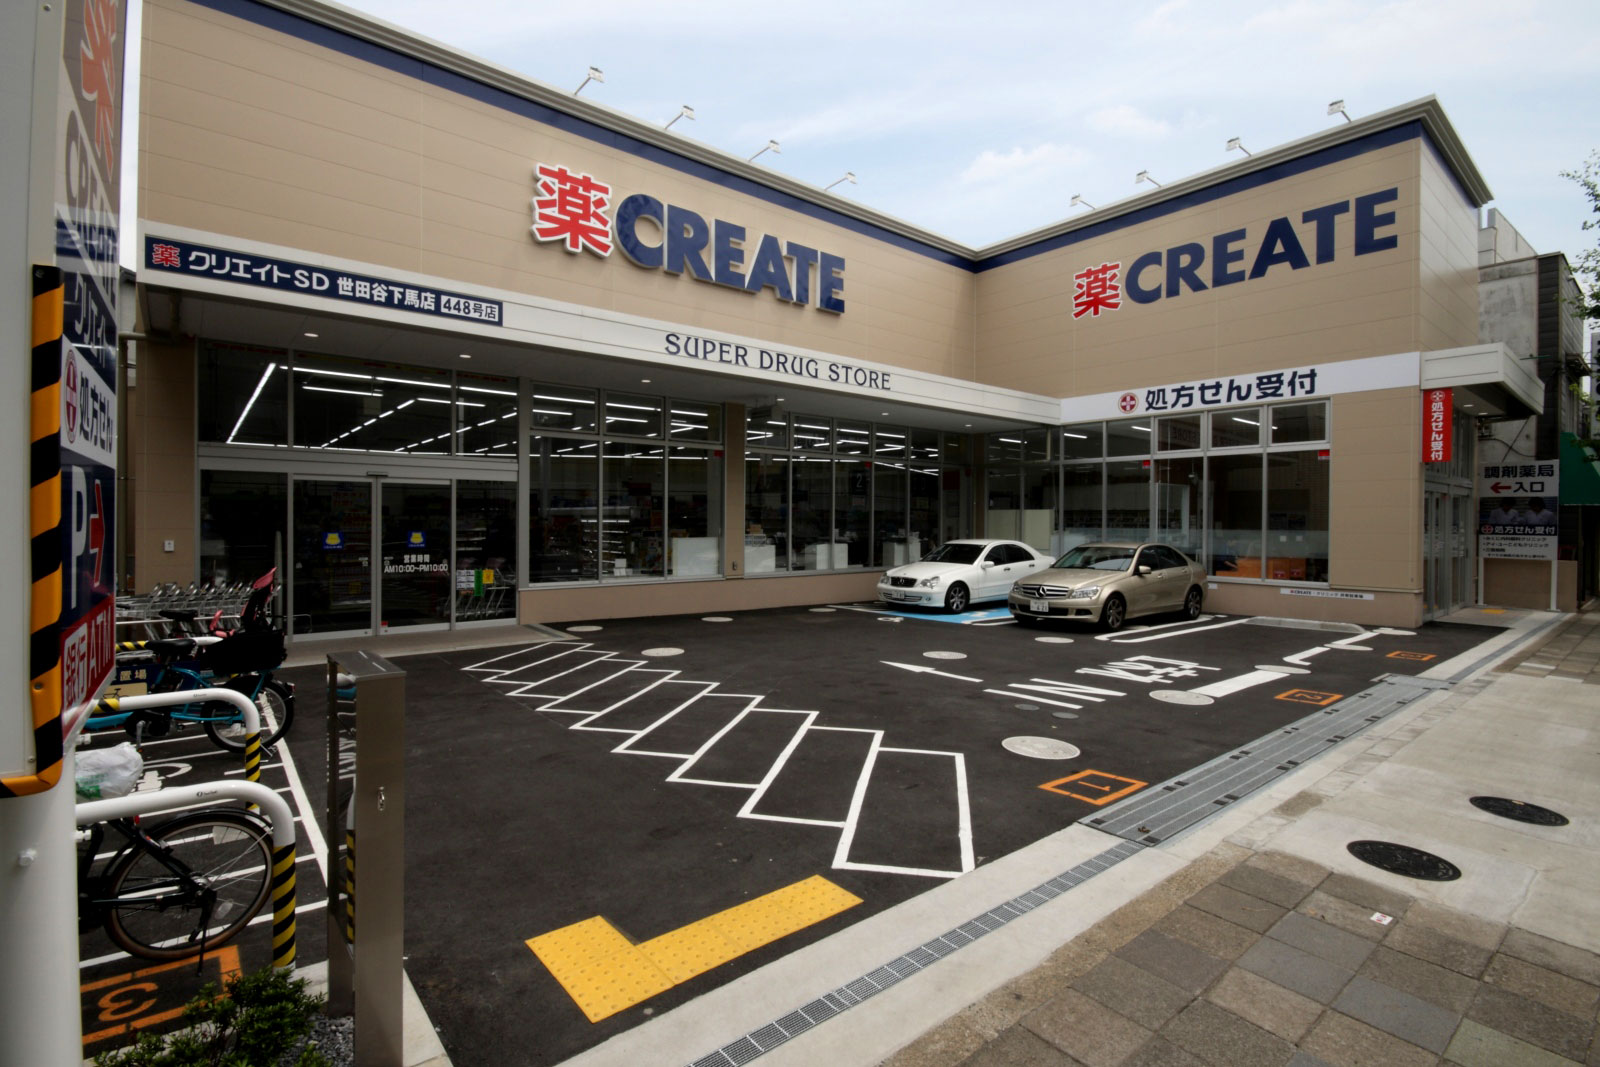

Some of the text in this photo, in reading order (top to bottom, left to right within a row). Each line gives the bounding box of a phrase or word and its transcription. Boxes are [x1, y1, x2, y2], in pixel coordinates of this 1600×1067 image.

[531, 162, 614, 258] 薬
[615, 193, 845, 315] CREATE
[1125, 187, 1398, 305] CREATE
[153, 243, 498, 320] 薬 クリエイトSD 世田谷下馬店 448号店
[1073, 261, 1122, 320] 薬
[665, 332, 892, 391] SUPER DRUG STORE
[1145, 368, 1318, 412] 処方せん受付
[1431, 401, 1444, 460] 処方せん受付
[1484, 464, 1554, 478] 調剤薬局
[1513, 481, 1545, 493] 入口
[71, 464, 88, 610] P
[403, 554, 430, 564] 営業時間
[1494, 525, 1556, 535] 処方せん受付
[88, 605, 111, 688] ATM
